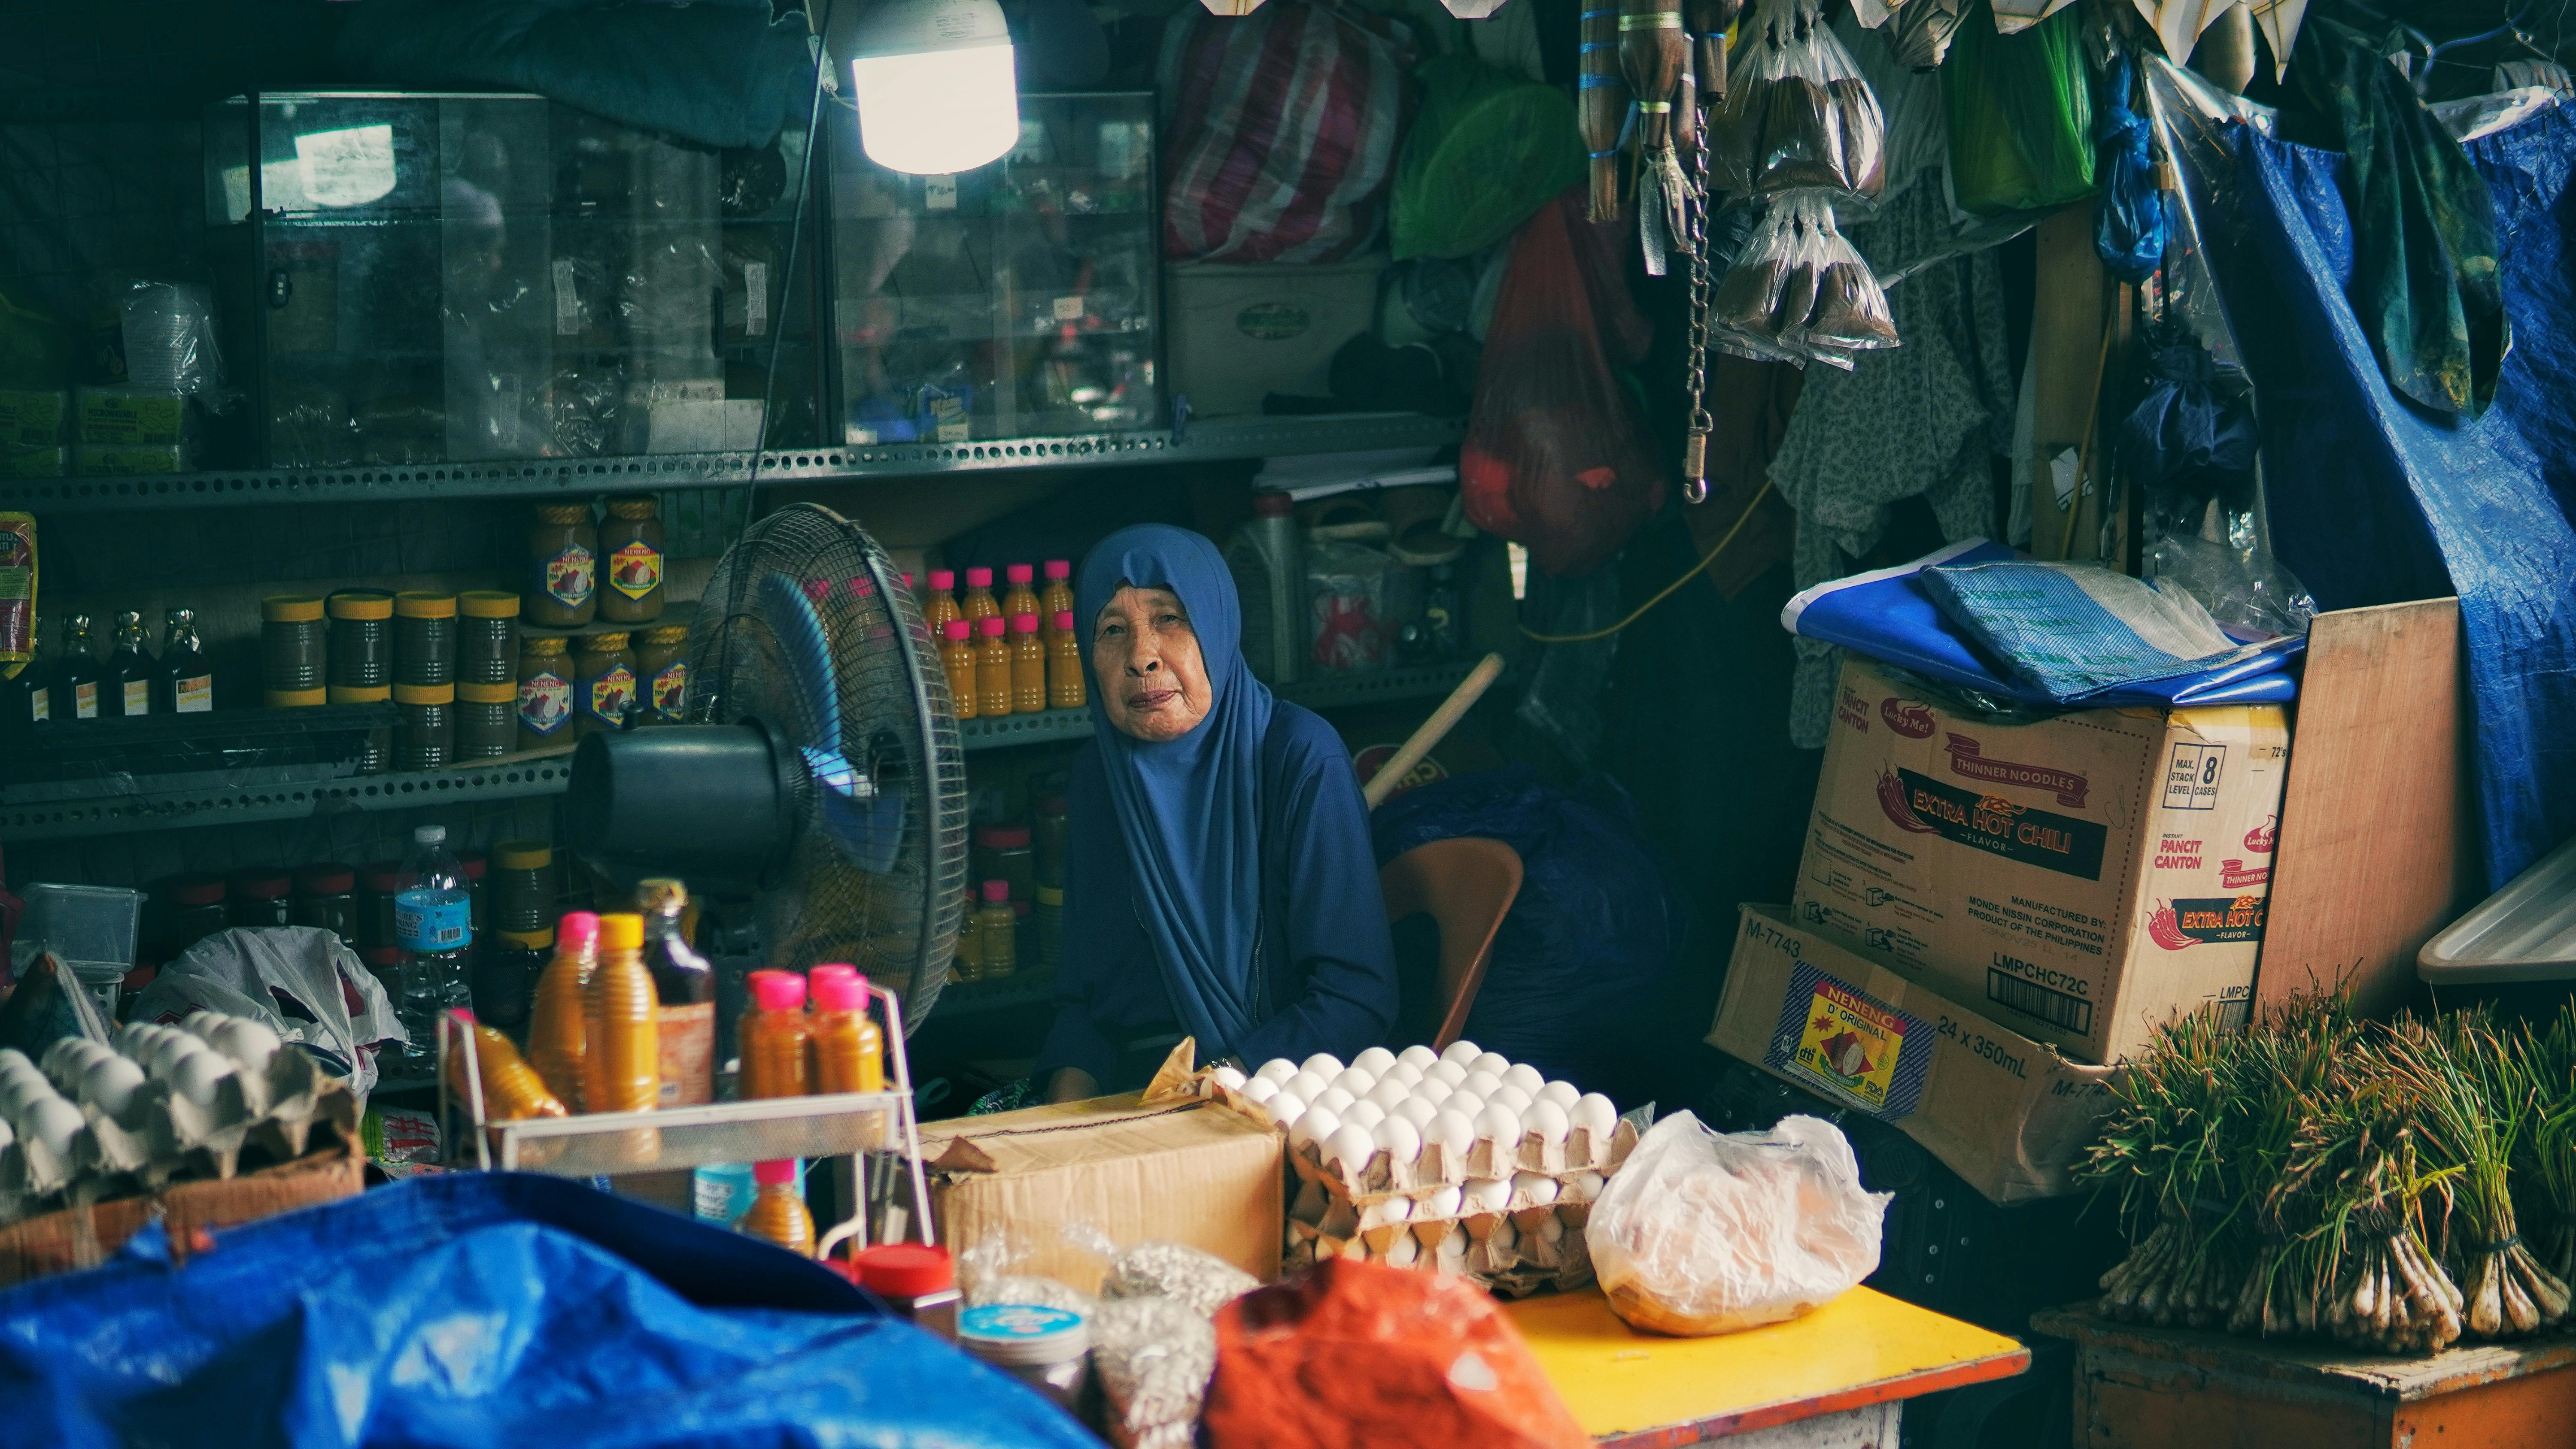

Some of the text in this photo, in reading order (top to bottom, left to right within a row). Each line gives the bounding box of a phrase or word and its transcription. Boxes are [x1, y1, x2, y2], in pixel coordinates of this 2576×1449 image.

[88, 409, 138, 418] MICROWAVABLE
[1842, 690, 1869, 716] PANCIT
[1838, 706, 1869, 734] CANTON
[1884, 707, 1929, 733] Lucky Me!
[2175, 759, 2194, 770] MAX.
[2271, 747, 2286, 757] 72's
[1957, 758, 2075, 791] THINNER NOODLES
[2170, 773, 2195, 782] STACK
[2203, 757, 2218, 784] 8
[2169, 785, 2190, 794] LEVEL
[2194, 787, 2216, 796] CASES
[1914, 788, 2072, 854] EXTRA HOT CHILI
[2160, 840, 2202, 854] PANCIT
[2247, 837, 2268, 847] Lucky
[2154, 855, 2202, 869] CANTON
[2227, 874, 2255, 884] THINNER
[1969, 896, 2105, 943] MONDE NISSIN CORPORATION
[2011, 895, 2106, 929] MANUFACTURED BY:
[2182, 911, 2224, 929] EXTRA
[2225, 909, 2254, 927] HOT
[1746, 918, 1801, 958] M-7743
[1968, 907, 2102, 956] PRODUCT OF THE PHILIPPINES
[1994, 951, 2088, 995] LMPCHC72C
[2220, 986, 2249, 999] LMPC
[1827, 986, 1895, 1030] NENENG
[1840, 1010, 1887, 1041] ORIGINAL
[1938, 1015, 1957, 1039] 24
[1974, 1035, 2027, 1080] 350mL
[1865, 1080, 1884, 1097] FDA
